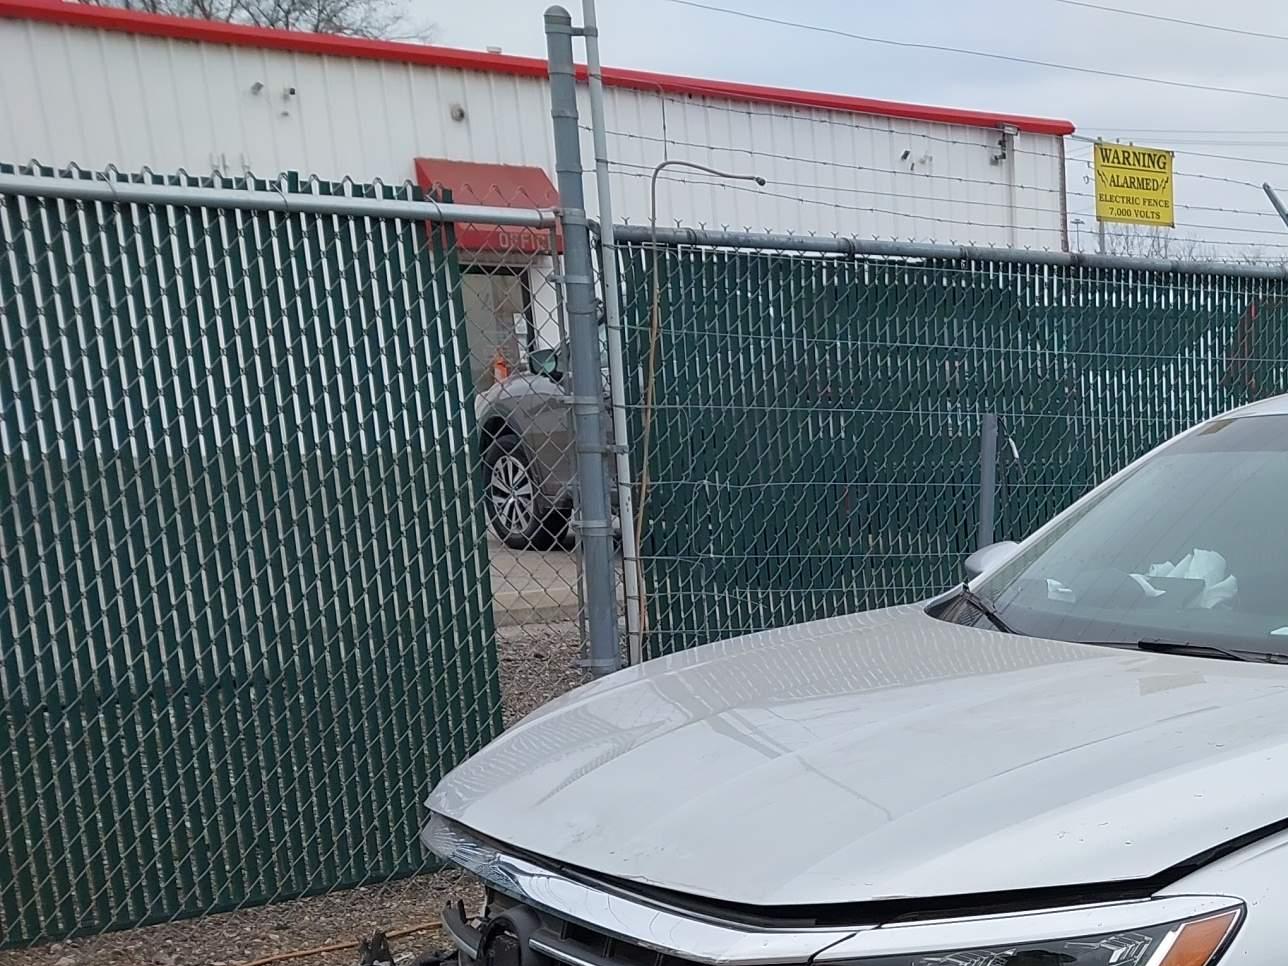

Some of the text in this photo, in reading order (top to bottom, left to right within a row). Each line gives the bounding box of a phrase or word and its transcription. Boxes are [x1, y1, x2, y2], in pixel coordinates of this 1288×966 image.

[1100, 147, 1167, 170] WARNING
[1109, 174, 1159, 191] ALARMED
[1099, 193, 1170, 208] ELECTRIC FENCE
[1109, 207, 1161, 220] 7,000 VOLTS
